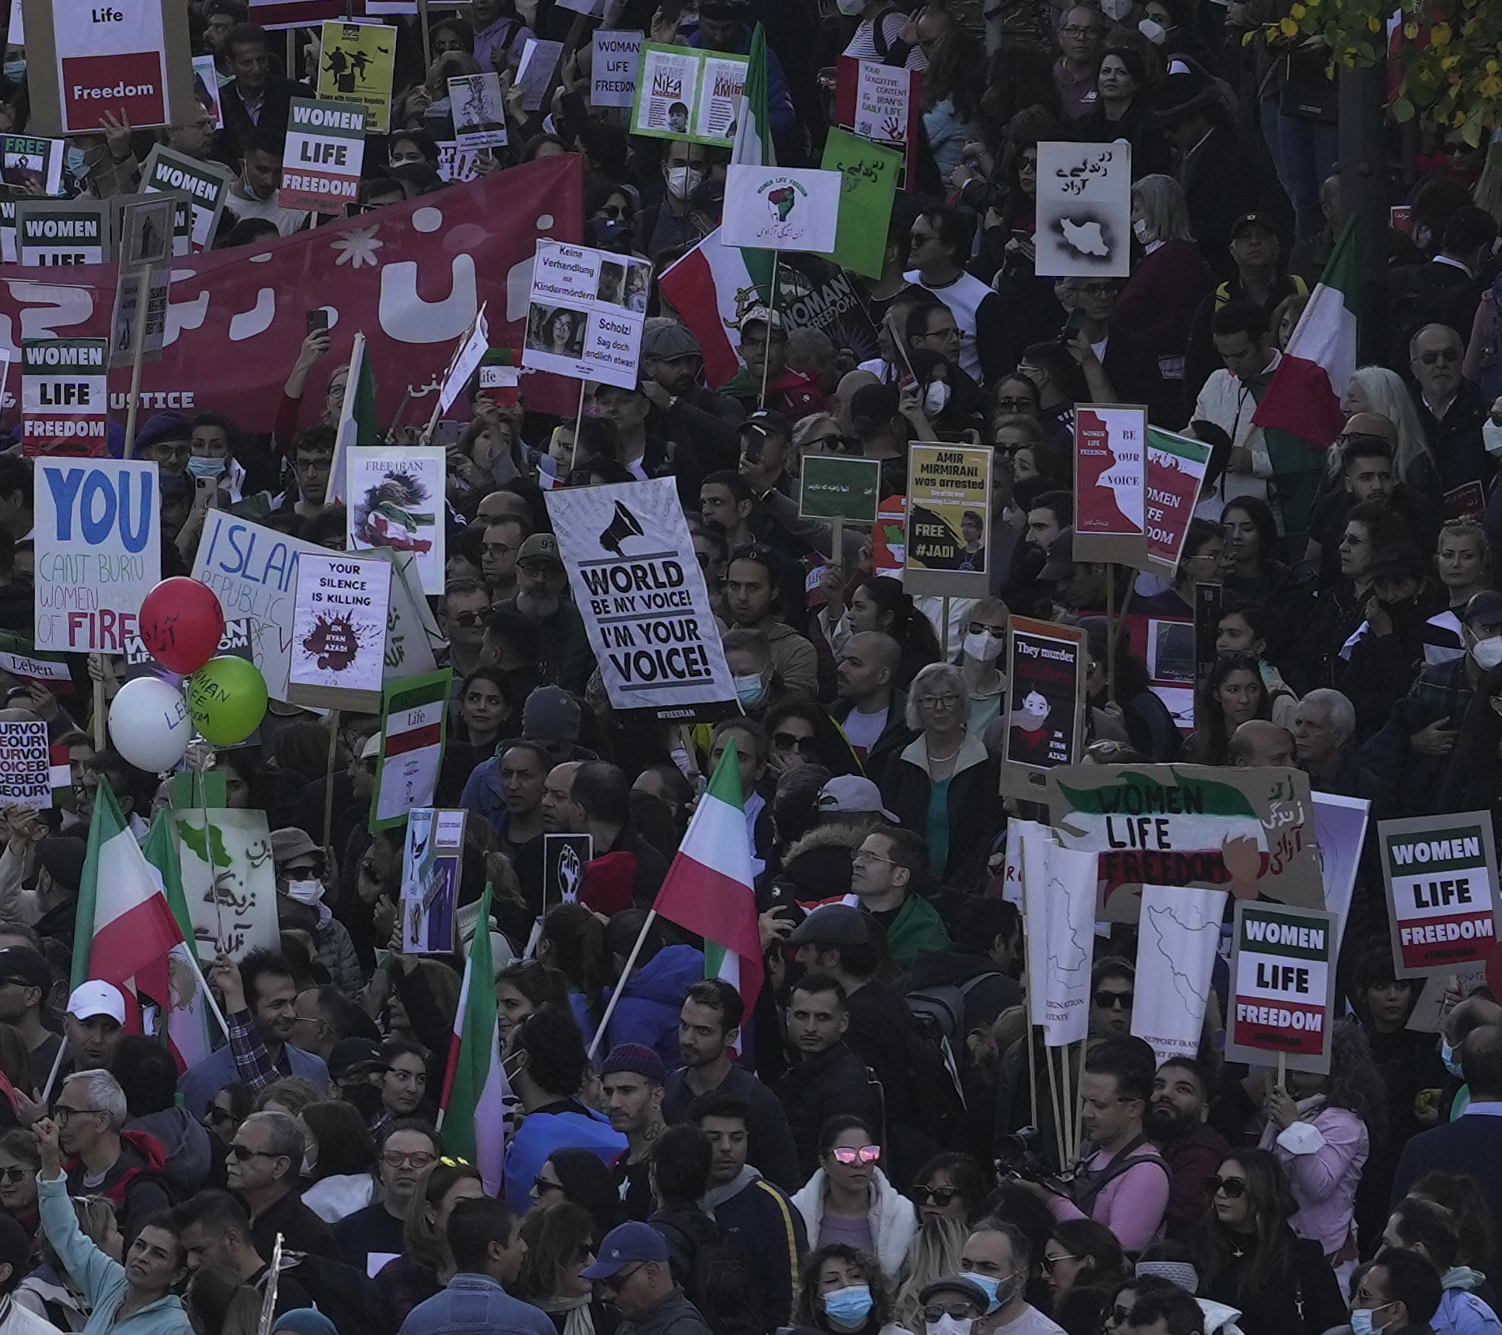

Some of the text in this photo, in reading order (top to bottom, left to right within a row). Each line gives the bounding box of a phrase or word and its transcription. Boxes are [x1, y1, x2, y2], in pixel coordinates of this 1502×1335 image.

[91, 6, 124, 25] Life
[73, 81, 154, 102] Freedom
[292, 106, 364, 131] WOMEN
[299, 141, 348, 167] LIFE
[281, 173, 357, 198] FREEDOM
[920, 462, 979, 478] MIRMIRANI
[935, 451, 965, 464] AMIR
[914, 476, 985, 491] was arrested
[43, 467, 150, 555] YOU
[915, 523, 945, 538] FREE
[915, 543, 954, 559] #JADI
[97, 551, 144, 582] BURN
[328, 562, 361, 575] YOUR
[580, 560, 687, 597] WORLD
[319, 577, 367, 591] SILENCE
[38, 586, 100, 612] WOMEN
[311, 592, 372, 607] IS KILLING
[591, 589, 693, 615] BE MY VOICE!
[37, 610, 138, 650] OF FIRE
[600, 617, 702, 650] I'M YOUR
[608, 644, 712, 683] VOICE!
[1244, 918, 1325, 951] WOMEN
[1255, 961, 1310, 995] LIFE
[1237, 1003, 1323, 1033] FREEDOM
